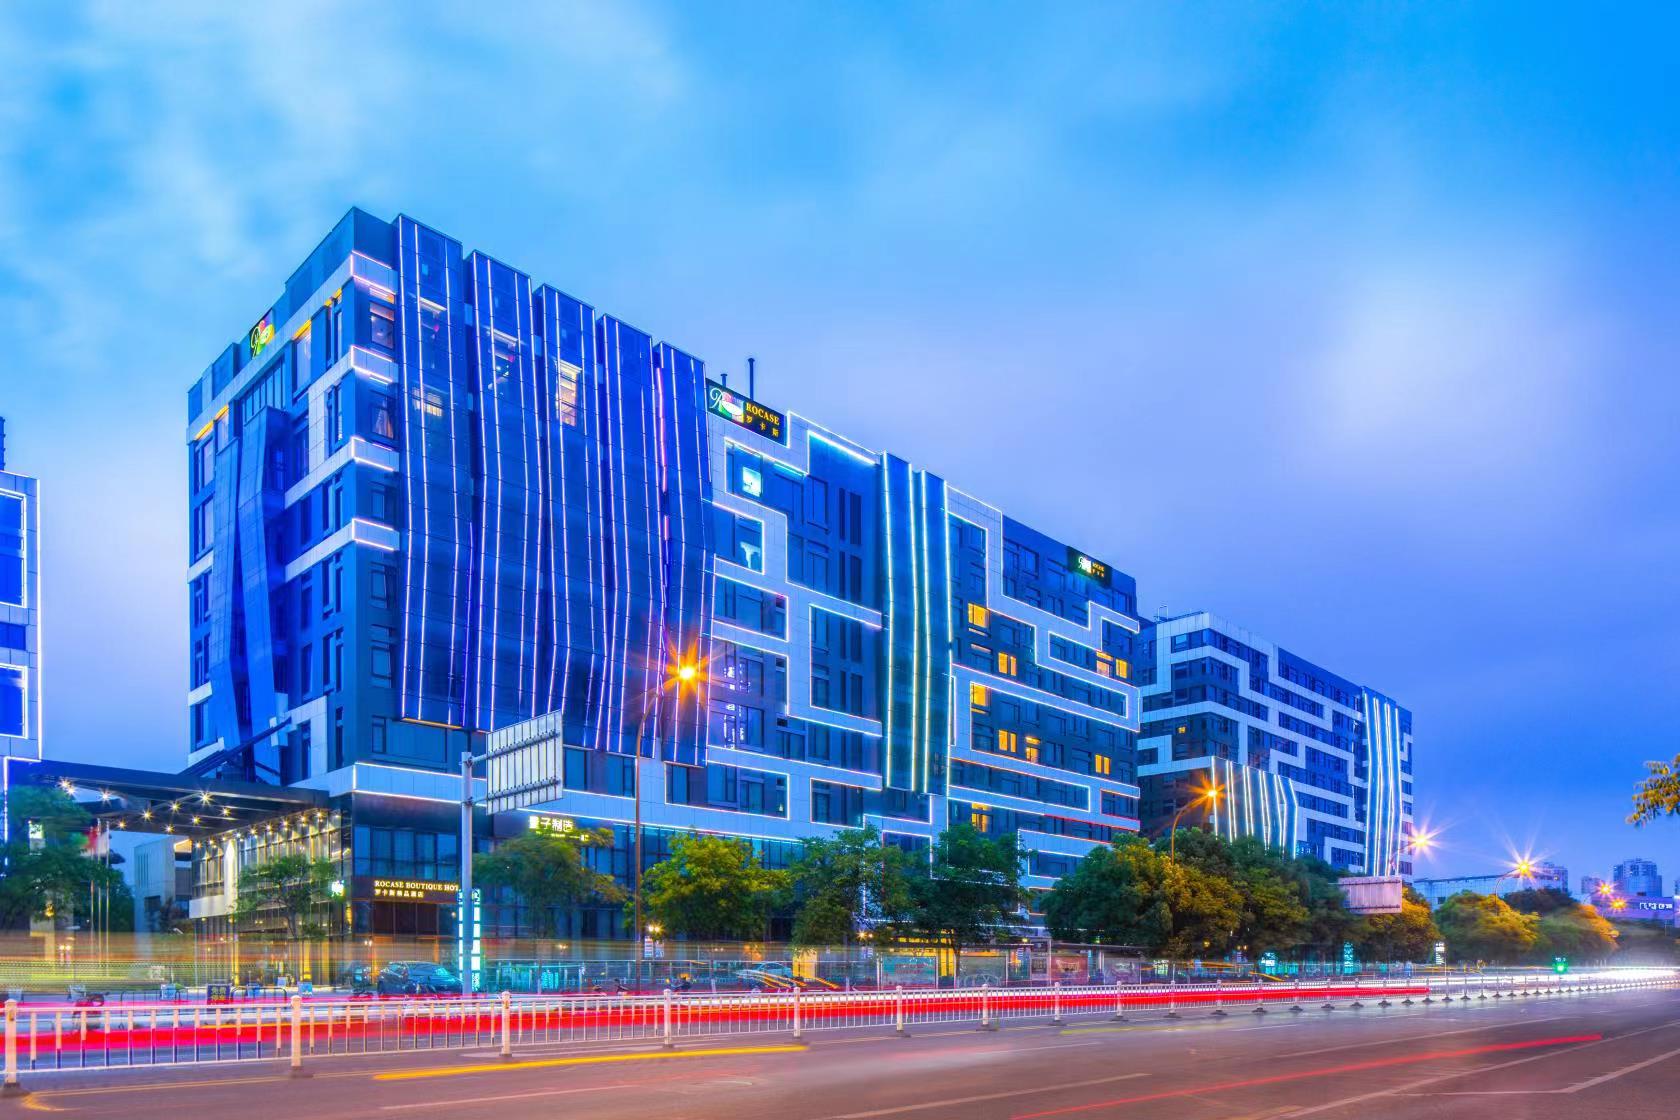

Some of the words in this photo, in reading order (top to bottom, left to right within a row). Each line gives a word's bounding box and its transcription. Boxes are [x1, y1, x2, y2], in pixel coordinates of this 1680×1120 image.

[745, 402, 780, 426] ROCASE
[374, 879, 404, 888] ROCASE
[406, 881, 443, 890] BOUTIQUE
